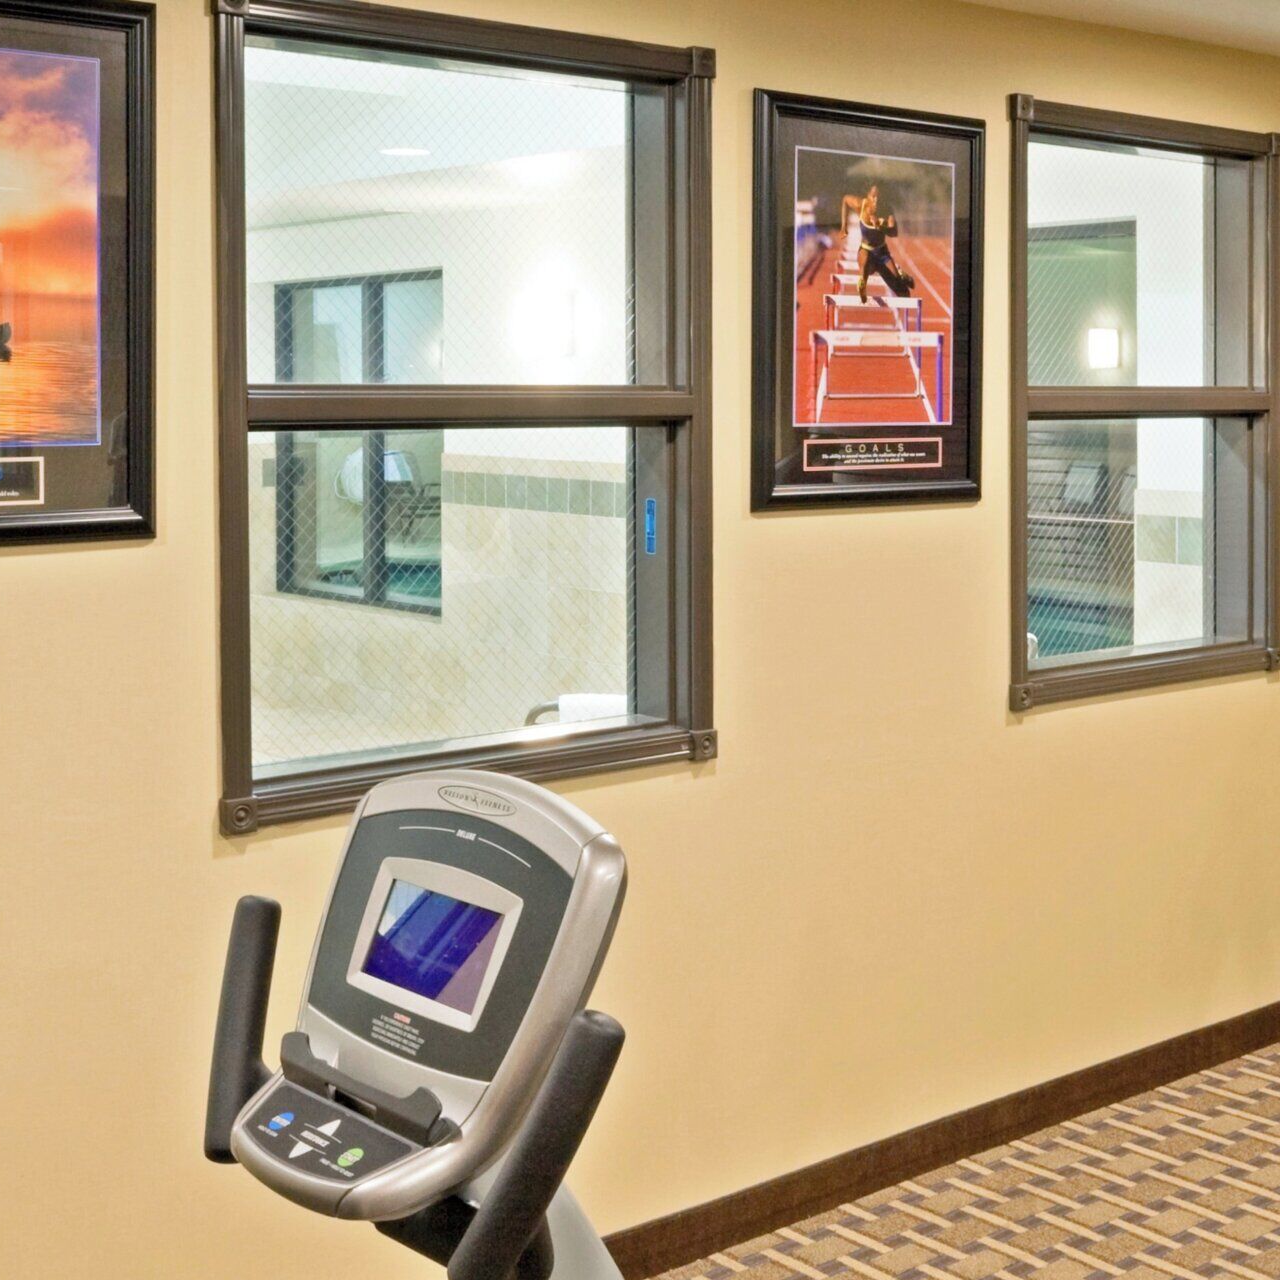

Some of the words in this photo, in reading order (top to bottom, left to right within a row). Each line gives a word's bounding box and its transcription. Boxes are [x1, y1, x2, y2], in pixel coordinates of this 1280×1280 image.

[845, 443, 904, 453] GOALS
[444, 789, 469, 801] VISION
[480, 799, 511, 812] FITNESS
